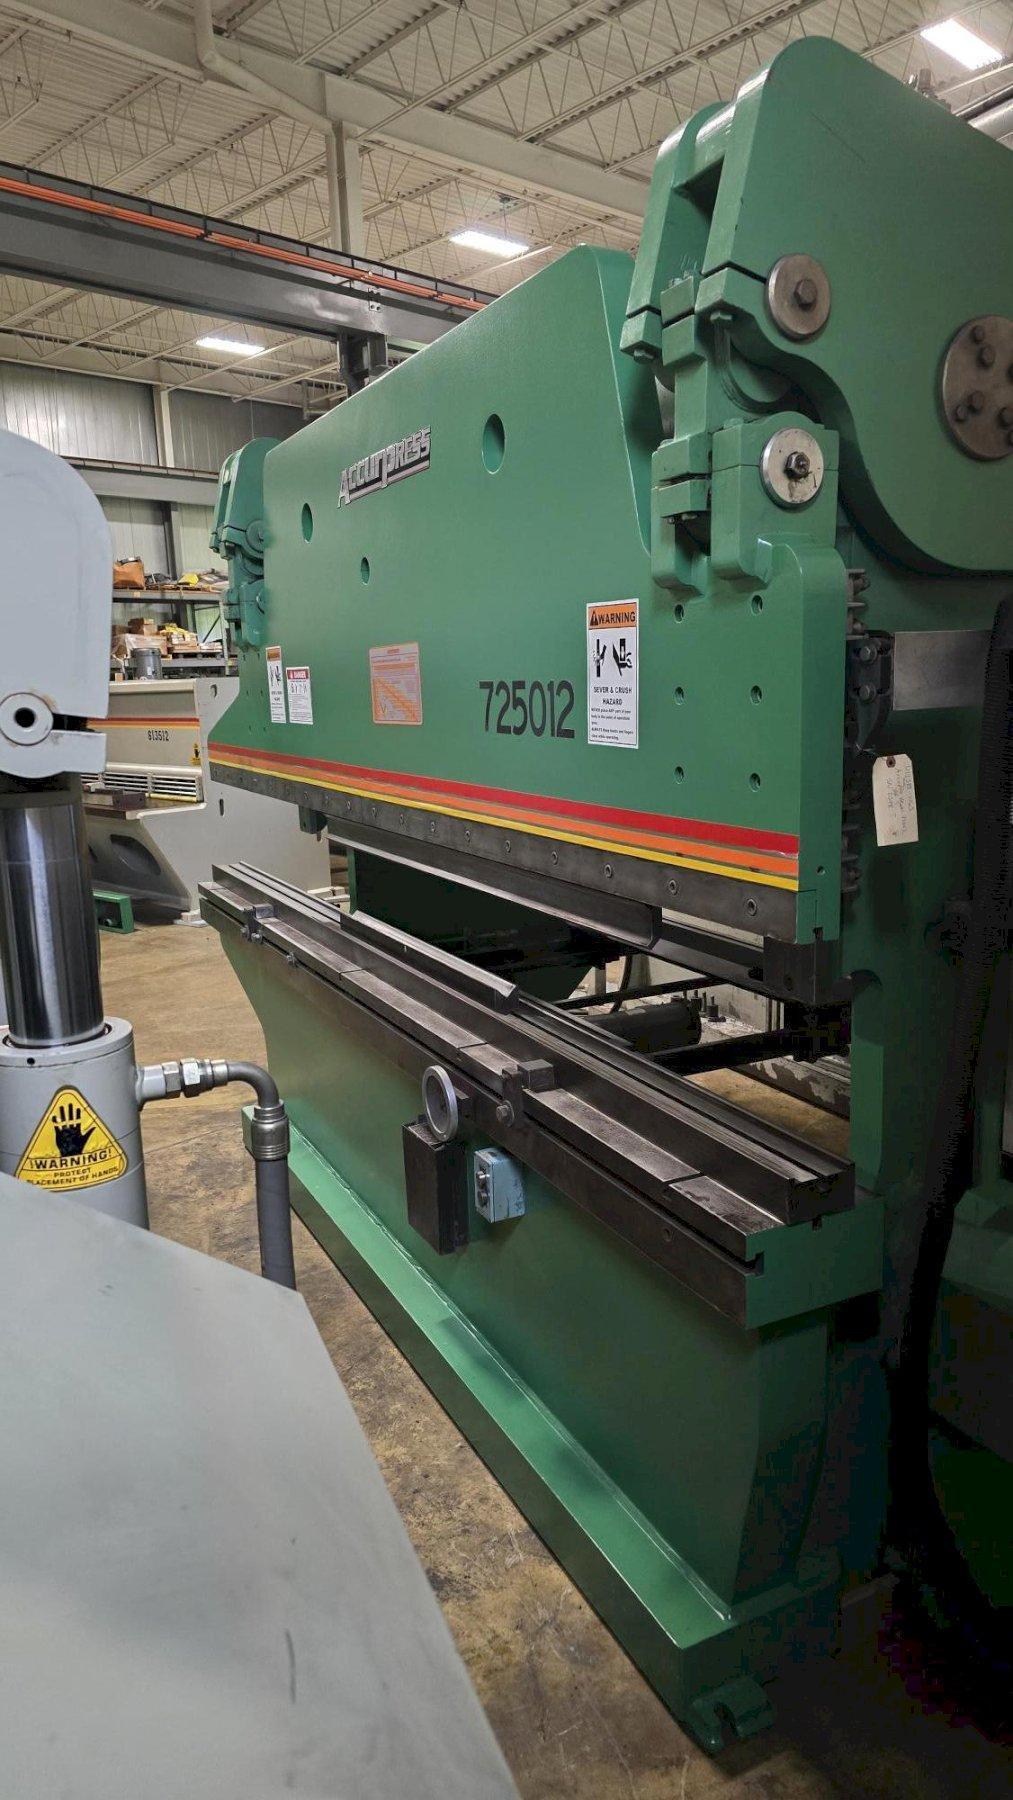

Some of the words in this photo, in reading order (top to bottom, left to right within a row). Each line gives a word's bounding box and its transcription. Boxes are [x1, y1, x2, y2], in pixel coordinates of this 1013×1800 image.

[598, 611, 636, 624] WARNING
[615, 686, 633, 694] CRUSH
[479, 680, 575, 739] 725012
[53, 1167, 91, 1178] PROTECT
[79, 1174, 90, 1182] OF
[91, 1166, 119, 1178] HANDS
